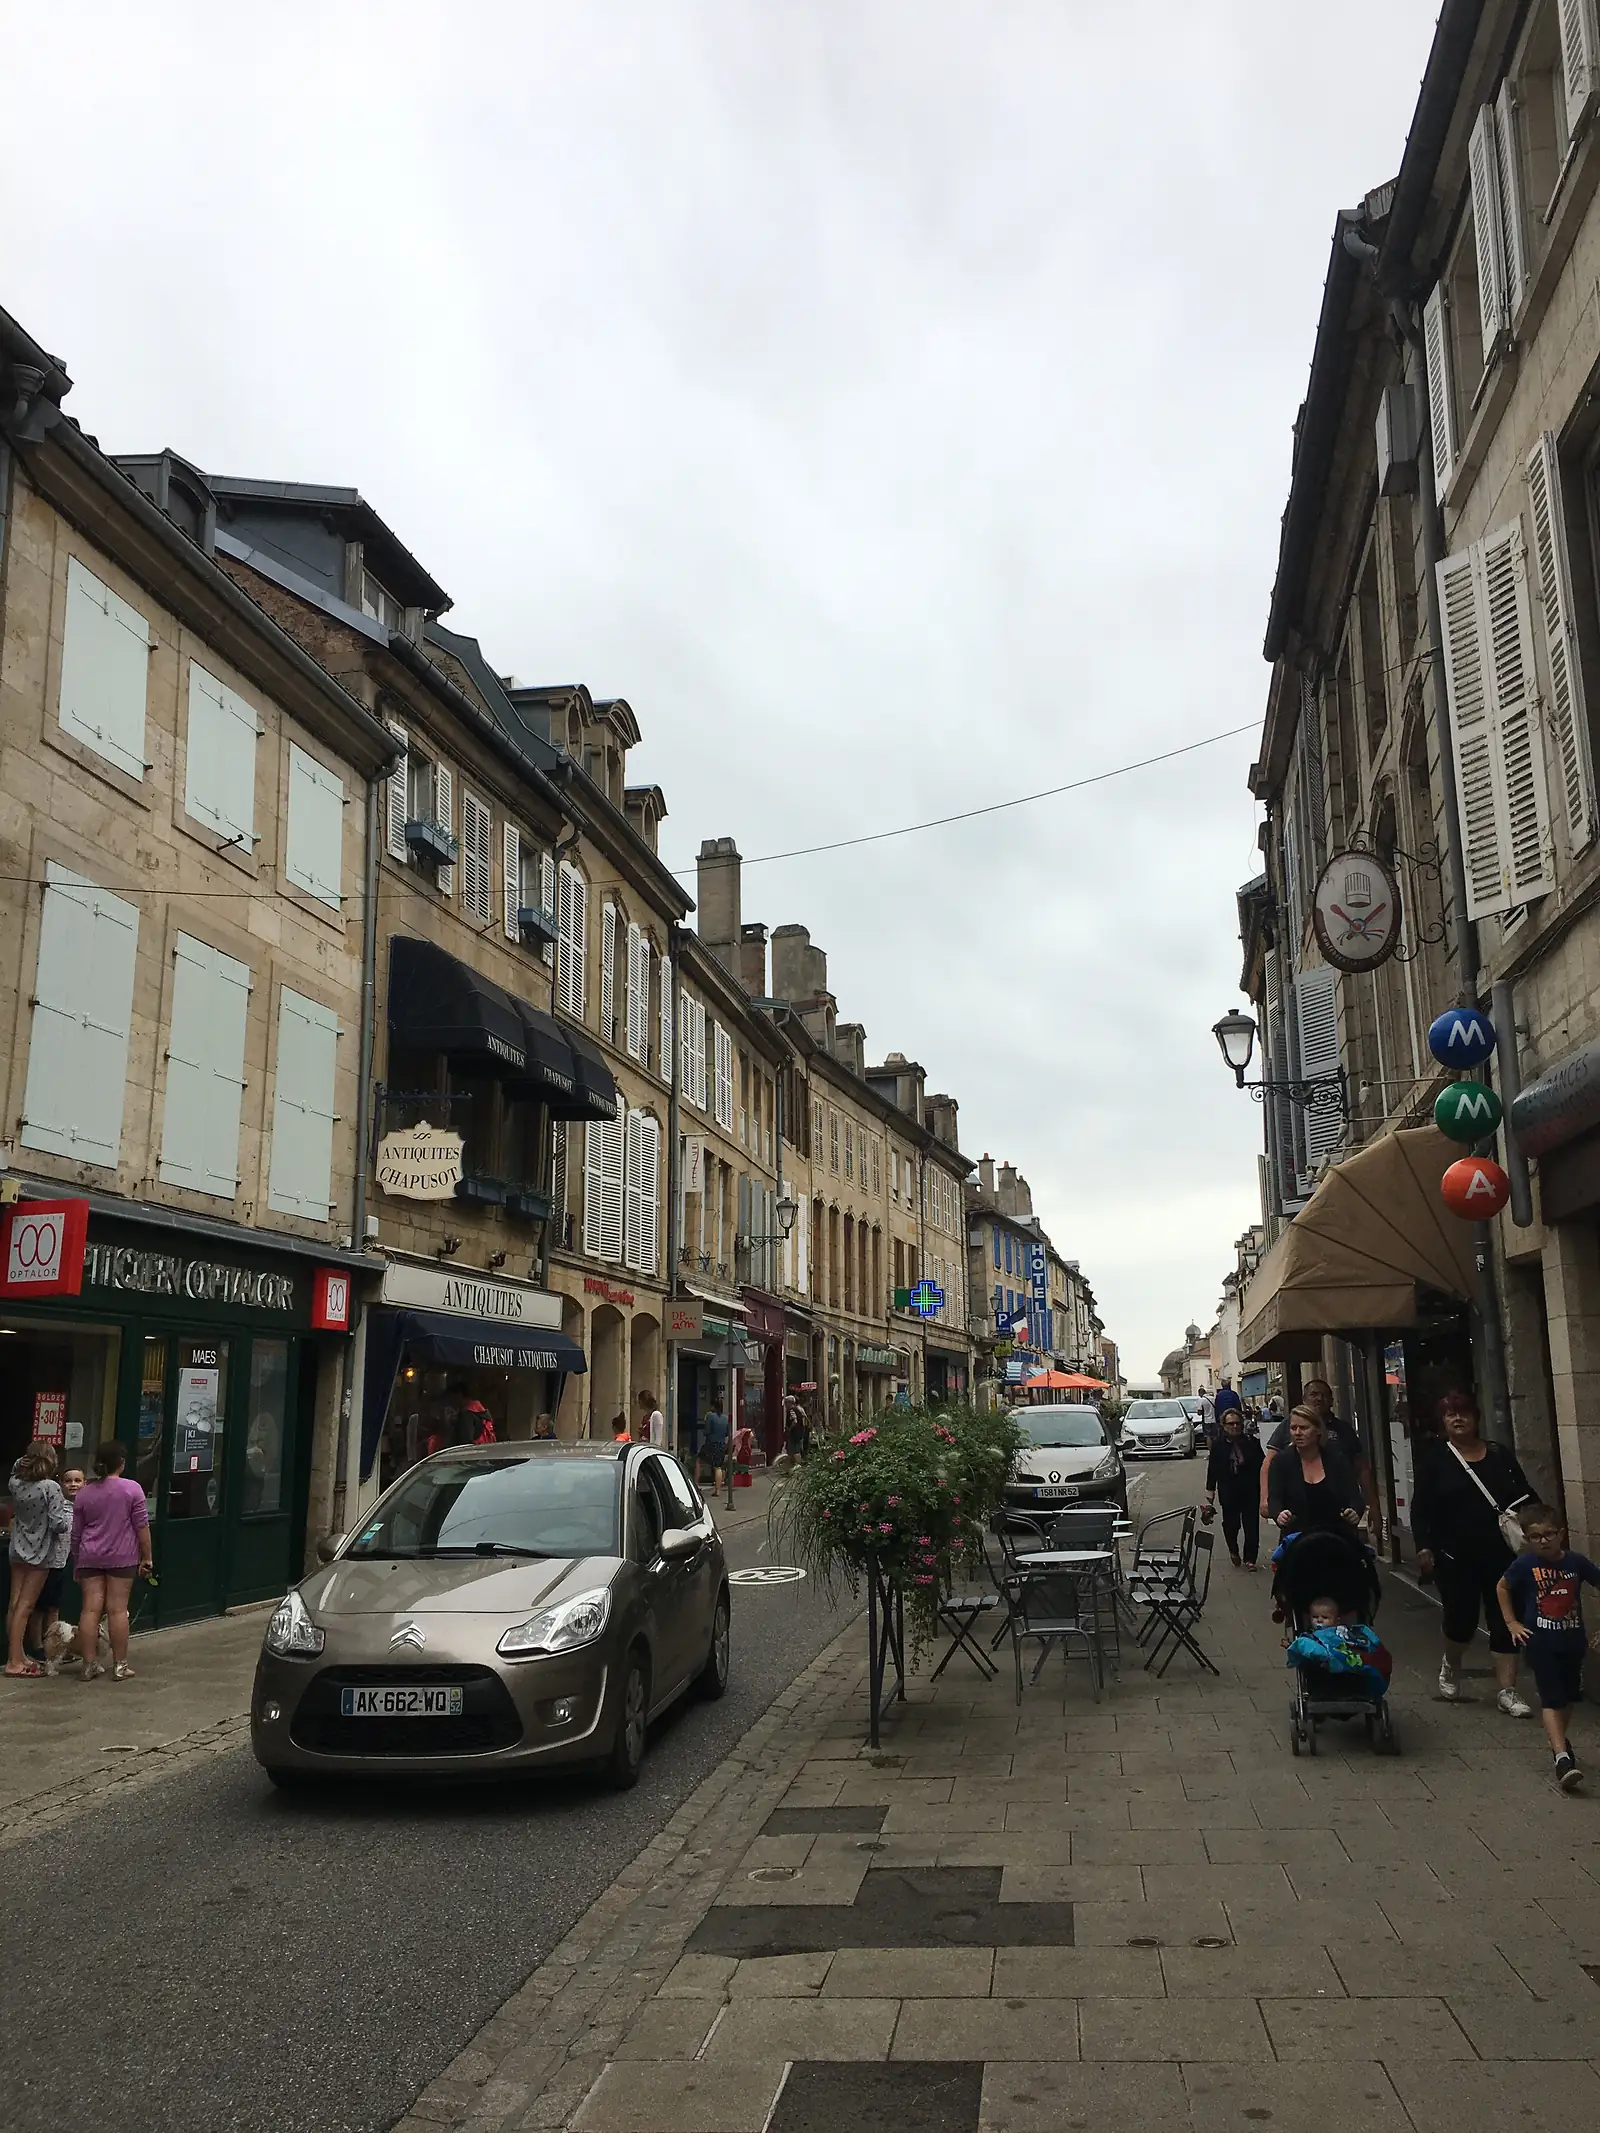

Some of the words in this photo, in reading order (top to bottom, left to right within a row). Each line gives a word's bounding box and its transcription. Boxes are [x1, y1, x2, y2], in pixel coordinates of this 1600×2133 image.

[1447, 1019, 1486, 1047] M
[487, 1035, 525, 1068] ANTIQUITES
[543, 1066, 574, 1094] CHAPUSOT
[1454, 1093, 1493, 1120] M
[382, 1147, 460, 1163] ANTIQUITES
[379, 1166, 458, 1190] CHAPUSOT
[1464, 1169, 1497, 1200] A
[9, 1268, 57, 1279] OPTALOR
[83, 1241, 182, 1295] PTICIEN
[184, 1260, 295, 1311] OPTALOR
[1031, 1244, 1045, 1313] HOTEL
[442, 1279, 523, 1318] ANTIQUITES
[998, 1313, 1008, 1326] P
[192, 1349, 217, 1365] MAES
[474, 1344, 514, 1367] CHAPUSOT
[517, 1349, 558, 1370] ANTIQUITES
